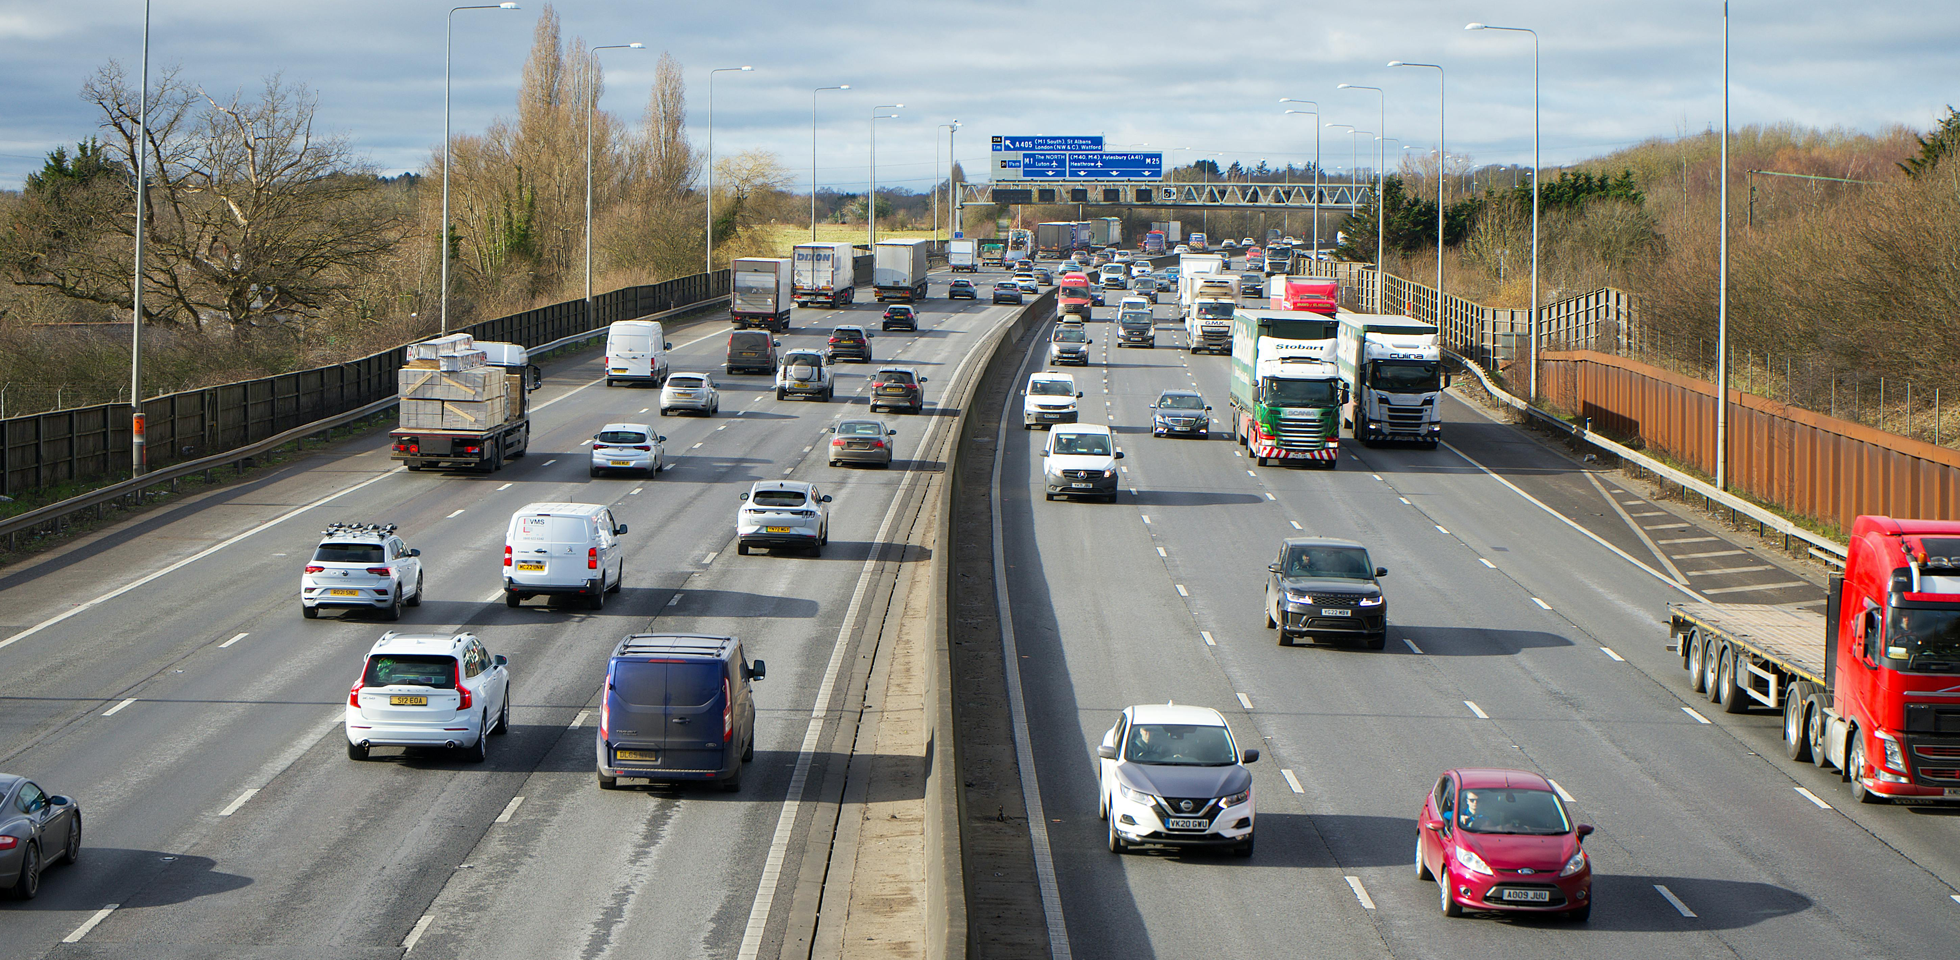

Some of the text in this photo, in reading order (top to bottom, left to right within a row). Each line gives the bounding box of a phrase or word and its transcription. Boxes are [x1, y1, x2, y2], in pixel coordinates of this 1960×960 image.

[1145, 157, 1160, 165] M25
[796, 253, 831, 262] DIXON
[1275, 343, 1324, 351] Stobart
[1170, 819, 1208, 828] VK20 GWU
[1530, 891, 1547, 900] JUU
